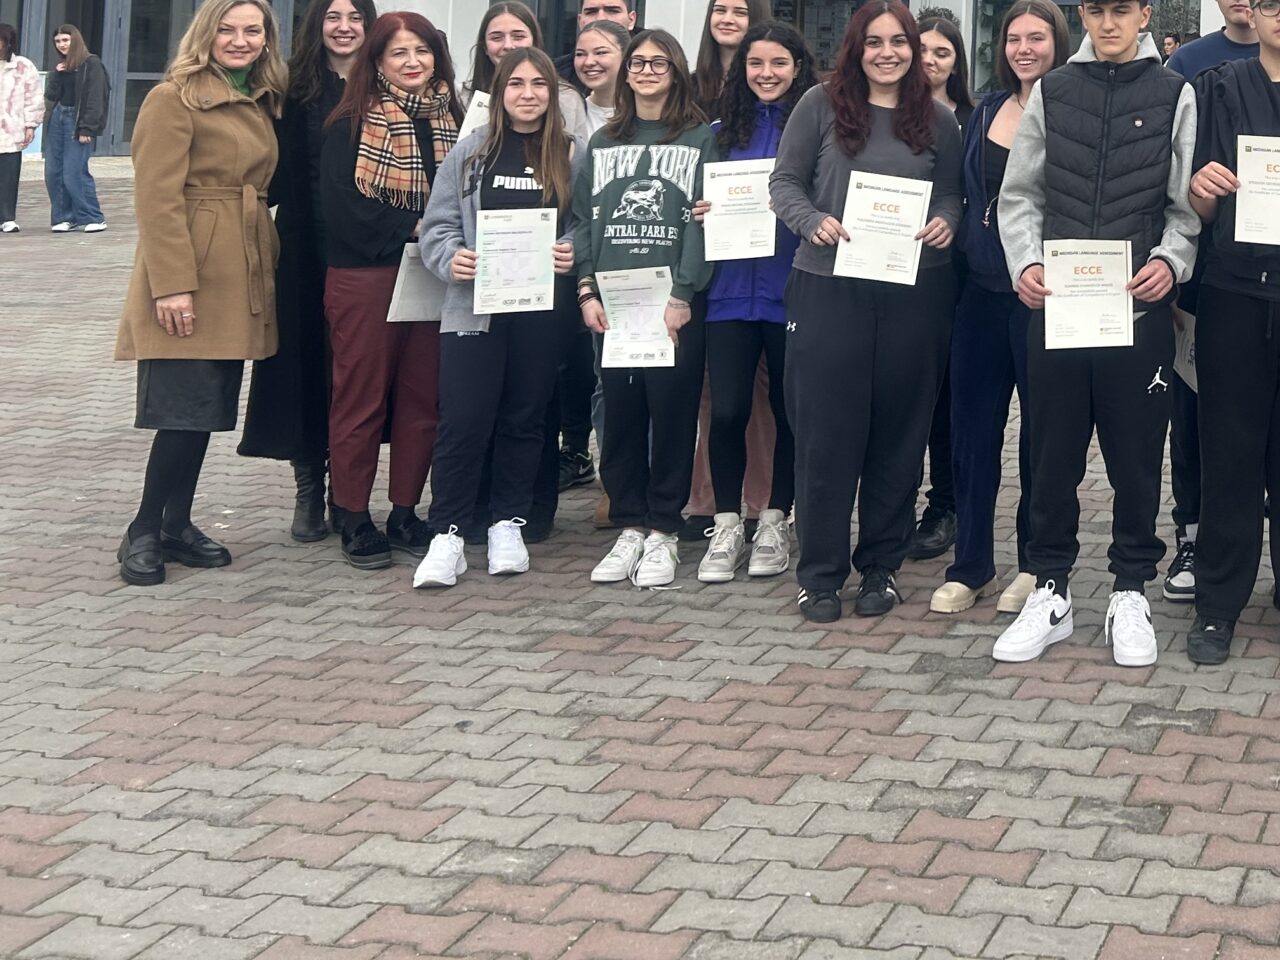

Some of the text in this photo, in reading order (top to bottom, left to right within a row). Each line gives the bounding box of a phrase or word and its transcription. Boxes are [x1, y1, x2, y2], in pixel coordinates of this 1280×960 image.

[592, 145, 701, 203] NEW YORK
[728, 185, 753, 195] ECCE
[872, 202, 901, 214] ECCE
[641, 224, 665, 238] PARK
[1073, 265, 1103, 275] ECCE
